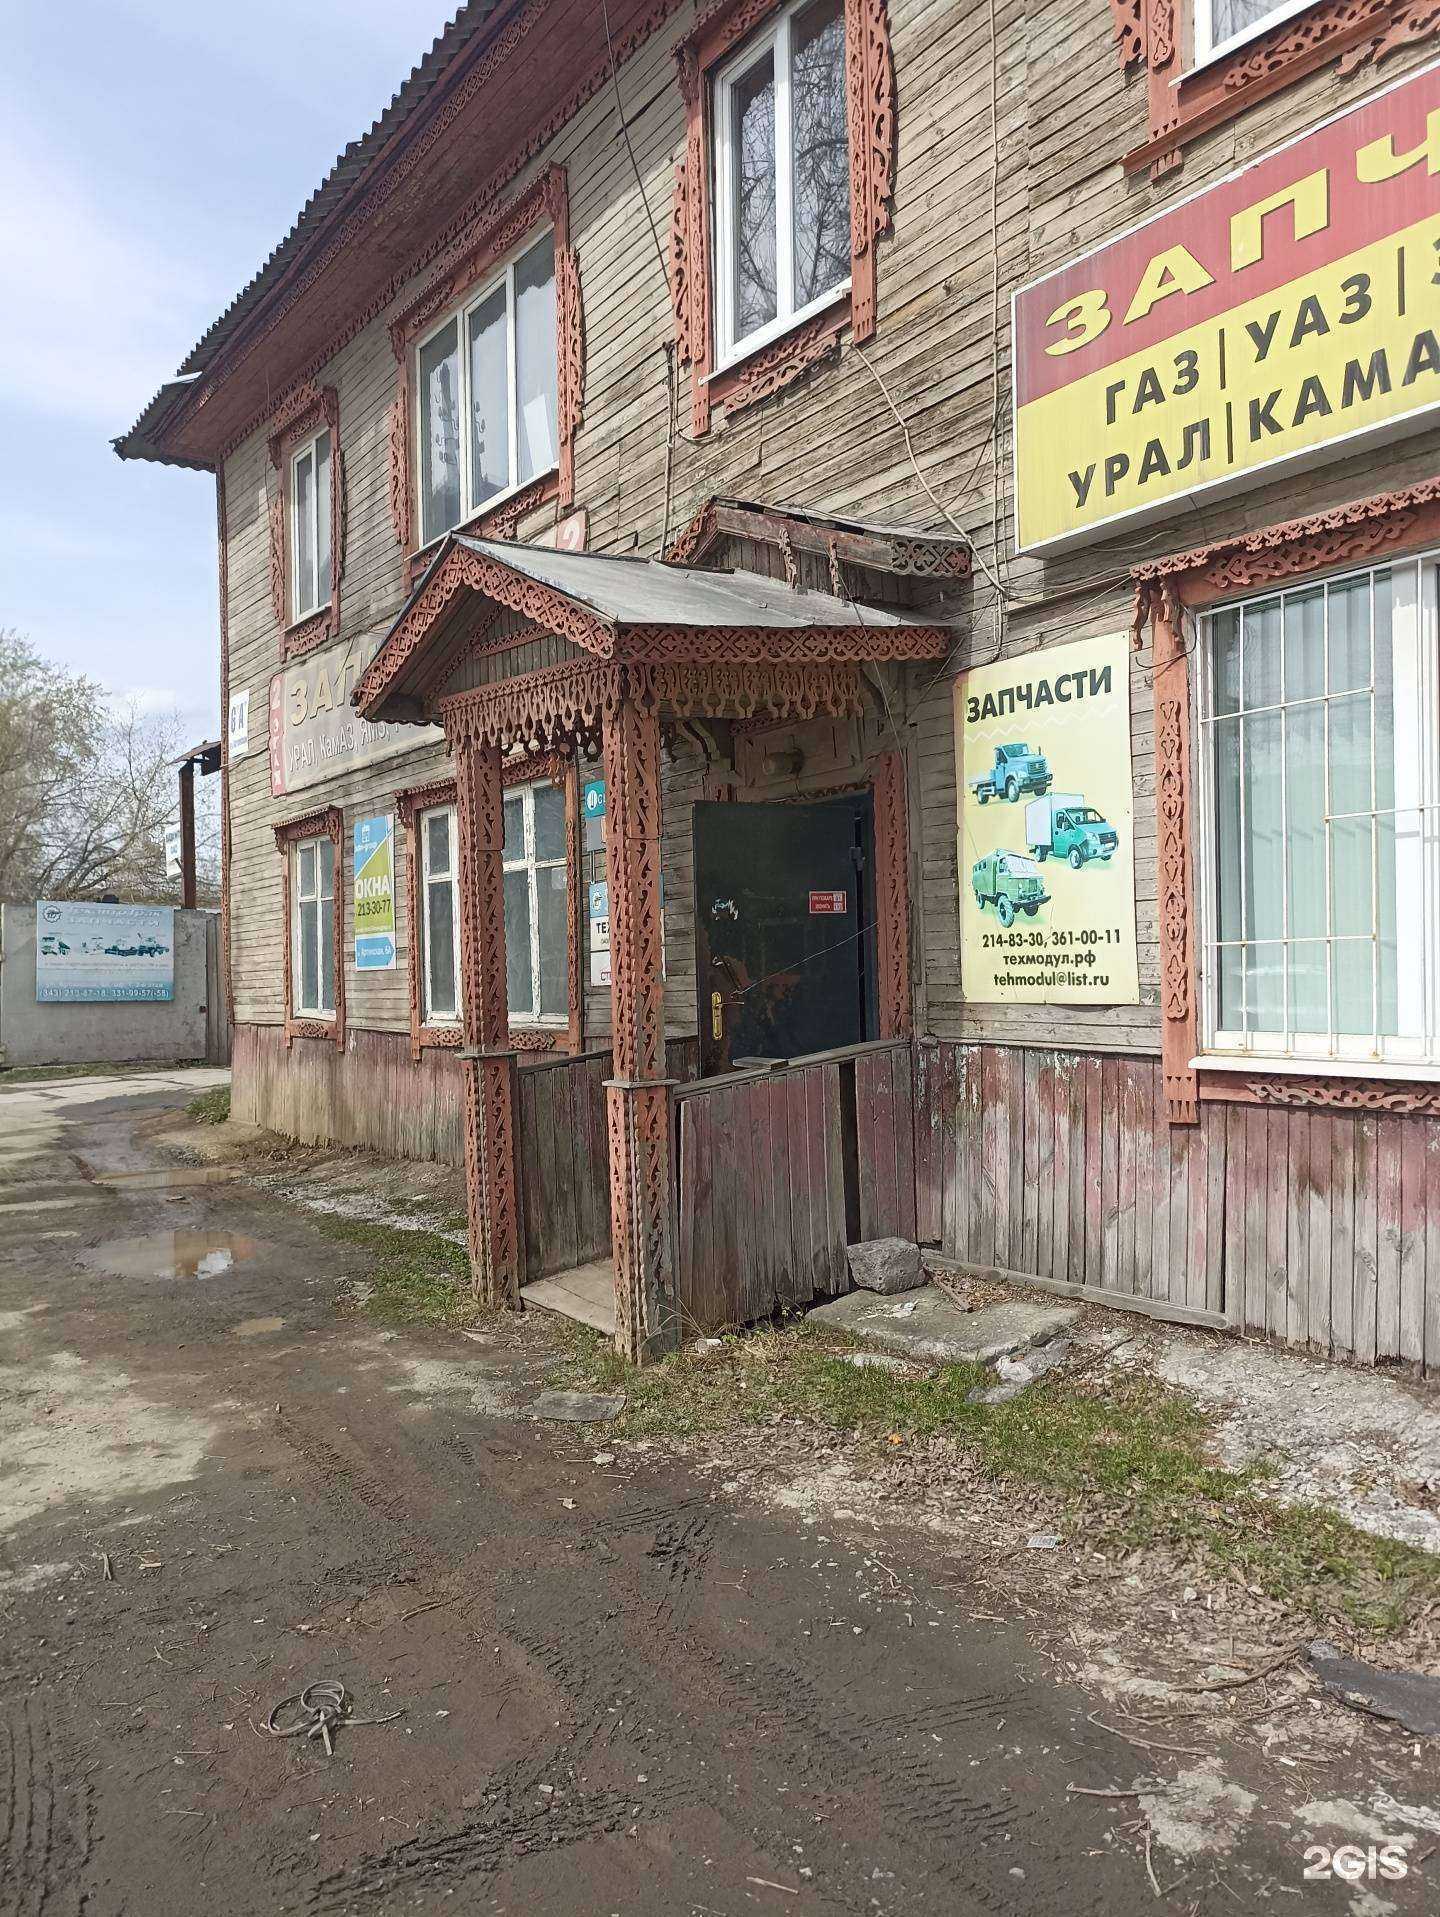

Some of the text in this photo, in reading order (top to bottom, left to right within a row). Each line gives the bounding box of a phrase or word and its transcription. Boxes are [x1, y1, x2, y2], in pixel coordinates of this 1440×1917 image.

[1106, 273, 1372, 426] ГАЗ УАЗ
[1068, 329, 1440, 508] УРАЛ КАМА
[967, 665, 1112, 723] ЗАПЧАСТИ
[355, 874, 391, 899] ОКНА
[982, 929, 1120, 948] 214-83-30, 361-00-11
[1003, 950, 1096, 968] техмодул.рф
[993, 971, 1110, 986] tehmodul@list.ru
